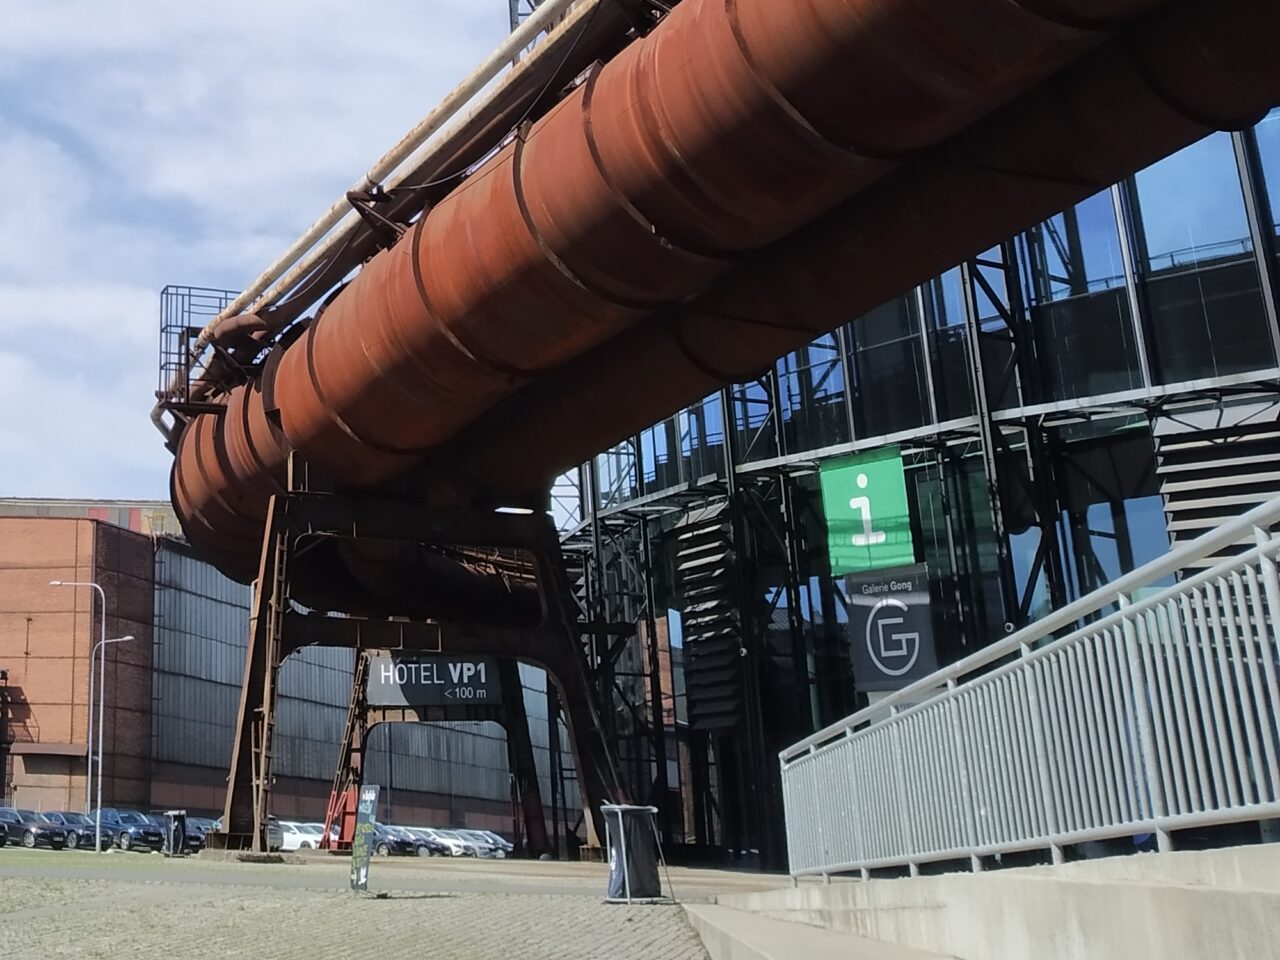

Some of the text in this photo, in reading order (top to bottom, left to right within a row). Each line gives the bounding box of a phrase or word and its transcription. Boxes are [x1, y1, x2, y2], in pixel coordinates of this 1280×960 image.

[861, 579, 913, 595] Galerie Gong
[381, 662, 486, 684] HOTEL VP1
[476, 689, 487, 699] m
